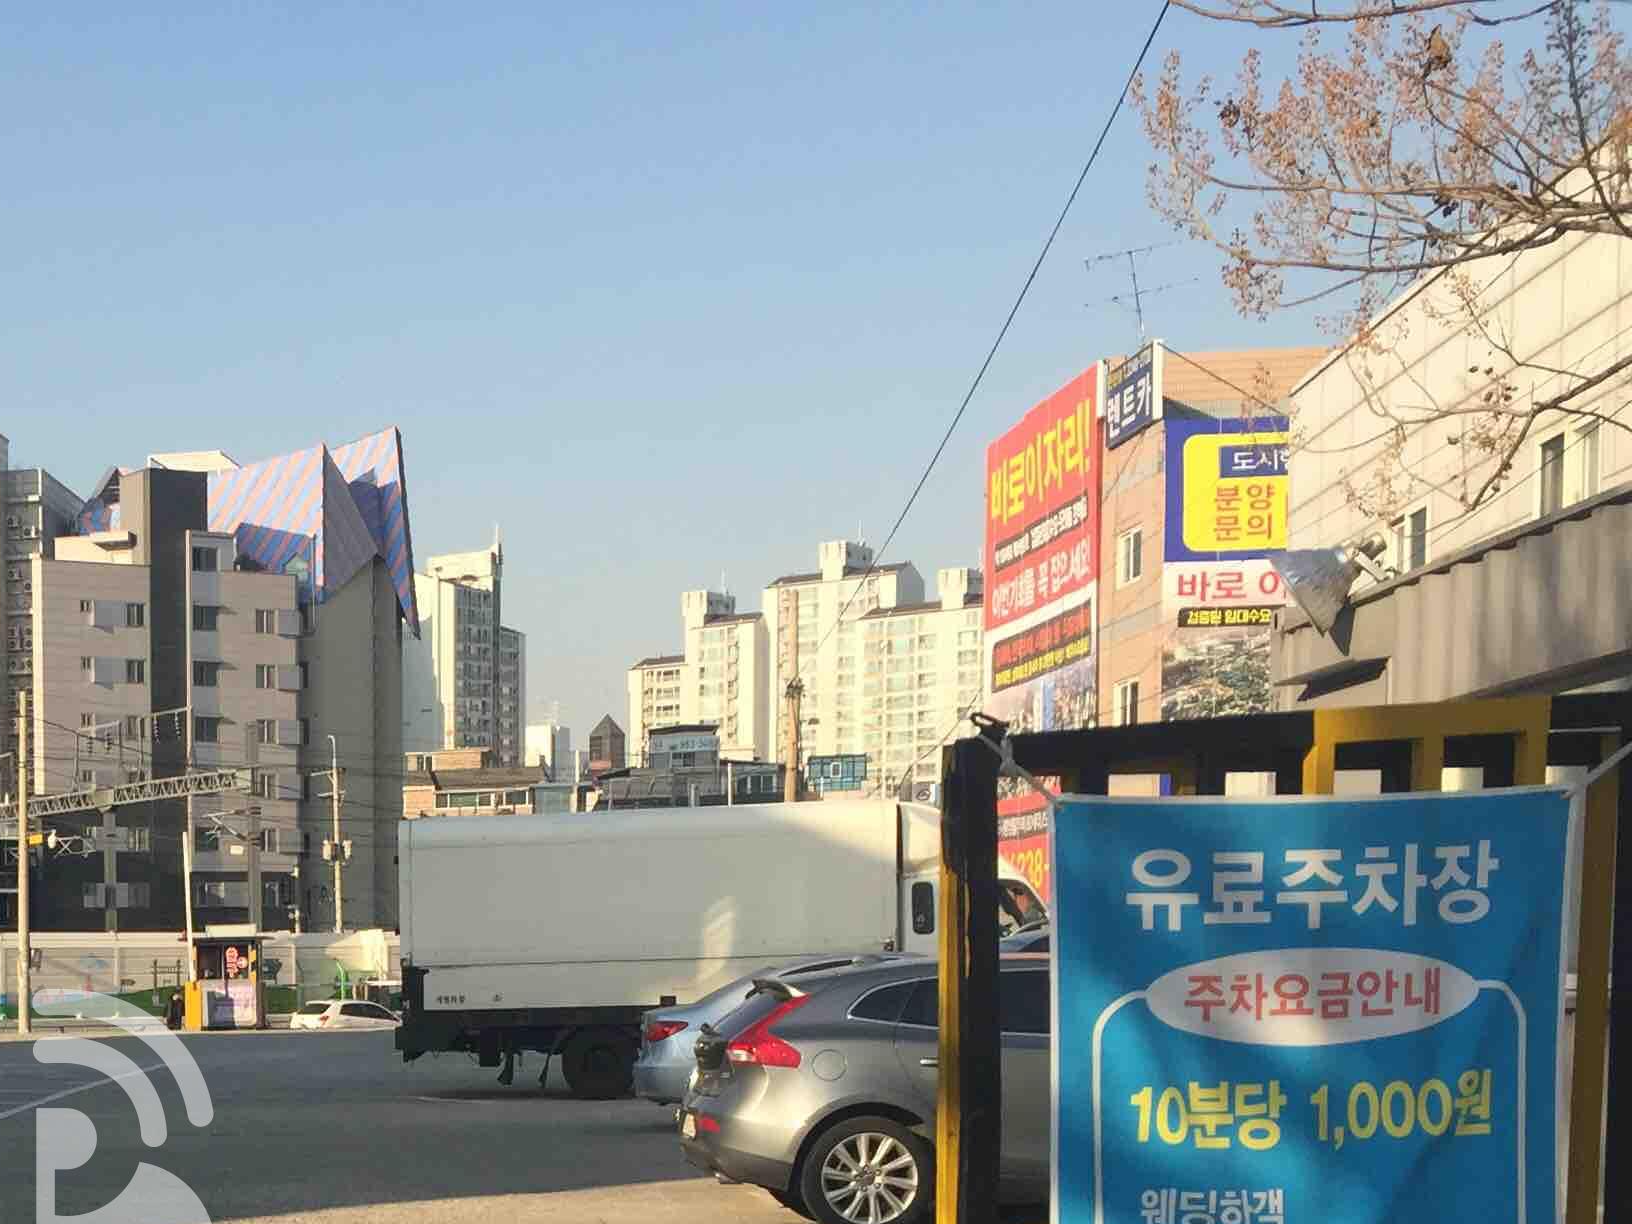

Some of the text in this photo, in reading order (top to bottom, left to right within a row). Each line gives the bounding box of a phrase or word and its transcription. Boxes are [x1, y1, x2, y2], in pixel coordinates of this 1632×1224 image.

[1107, 371, 1152, 438] 렌트카
[1214, 484, 1275, 511] 분양
[1214, 513, 1273, 541] 문의
[1178, 571, 1246, 601] 바로
[1126, 839, 1499, 931] 유료주차장
[1184, 968, 1441, 1023] 주차요금안내
[1130, 1069, 1494, 1151] 10분당 1,000원
